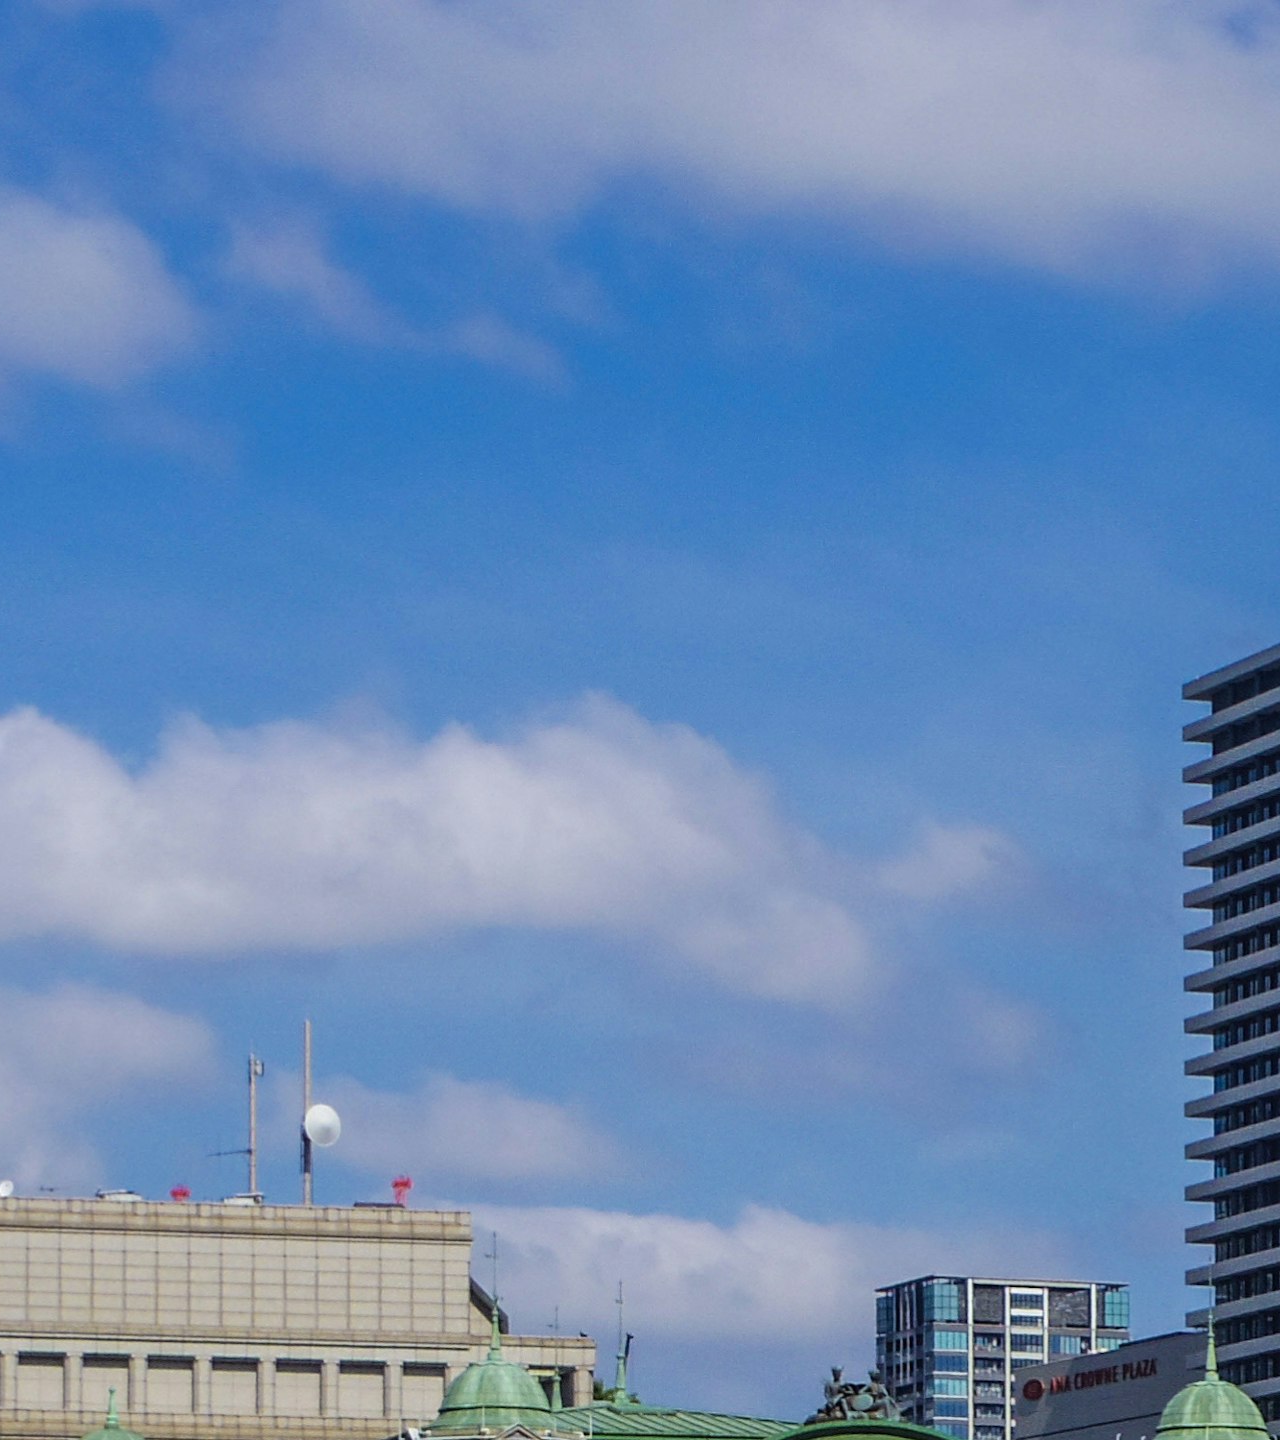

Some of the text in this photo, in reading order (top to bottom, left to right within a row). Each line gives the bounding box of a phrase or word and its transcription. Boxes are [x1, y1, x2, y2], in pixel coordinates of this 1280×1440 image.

[1050, 1358, 1157, 1394] ANA CROWNE PLAZA
